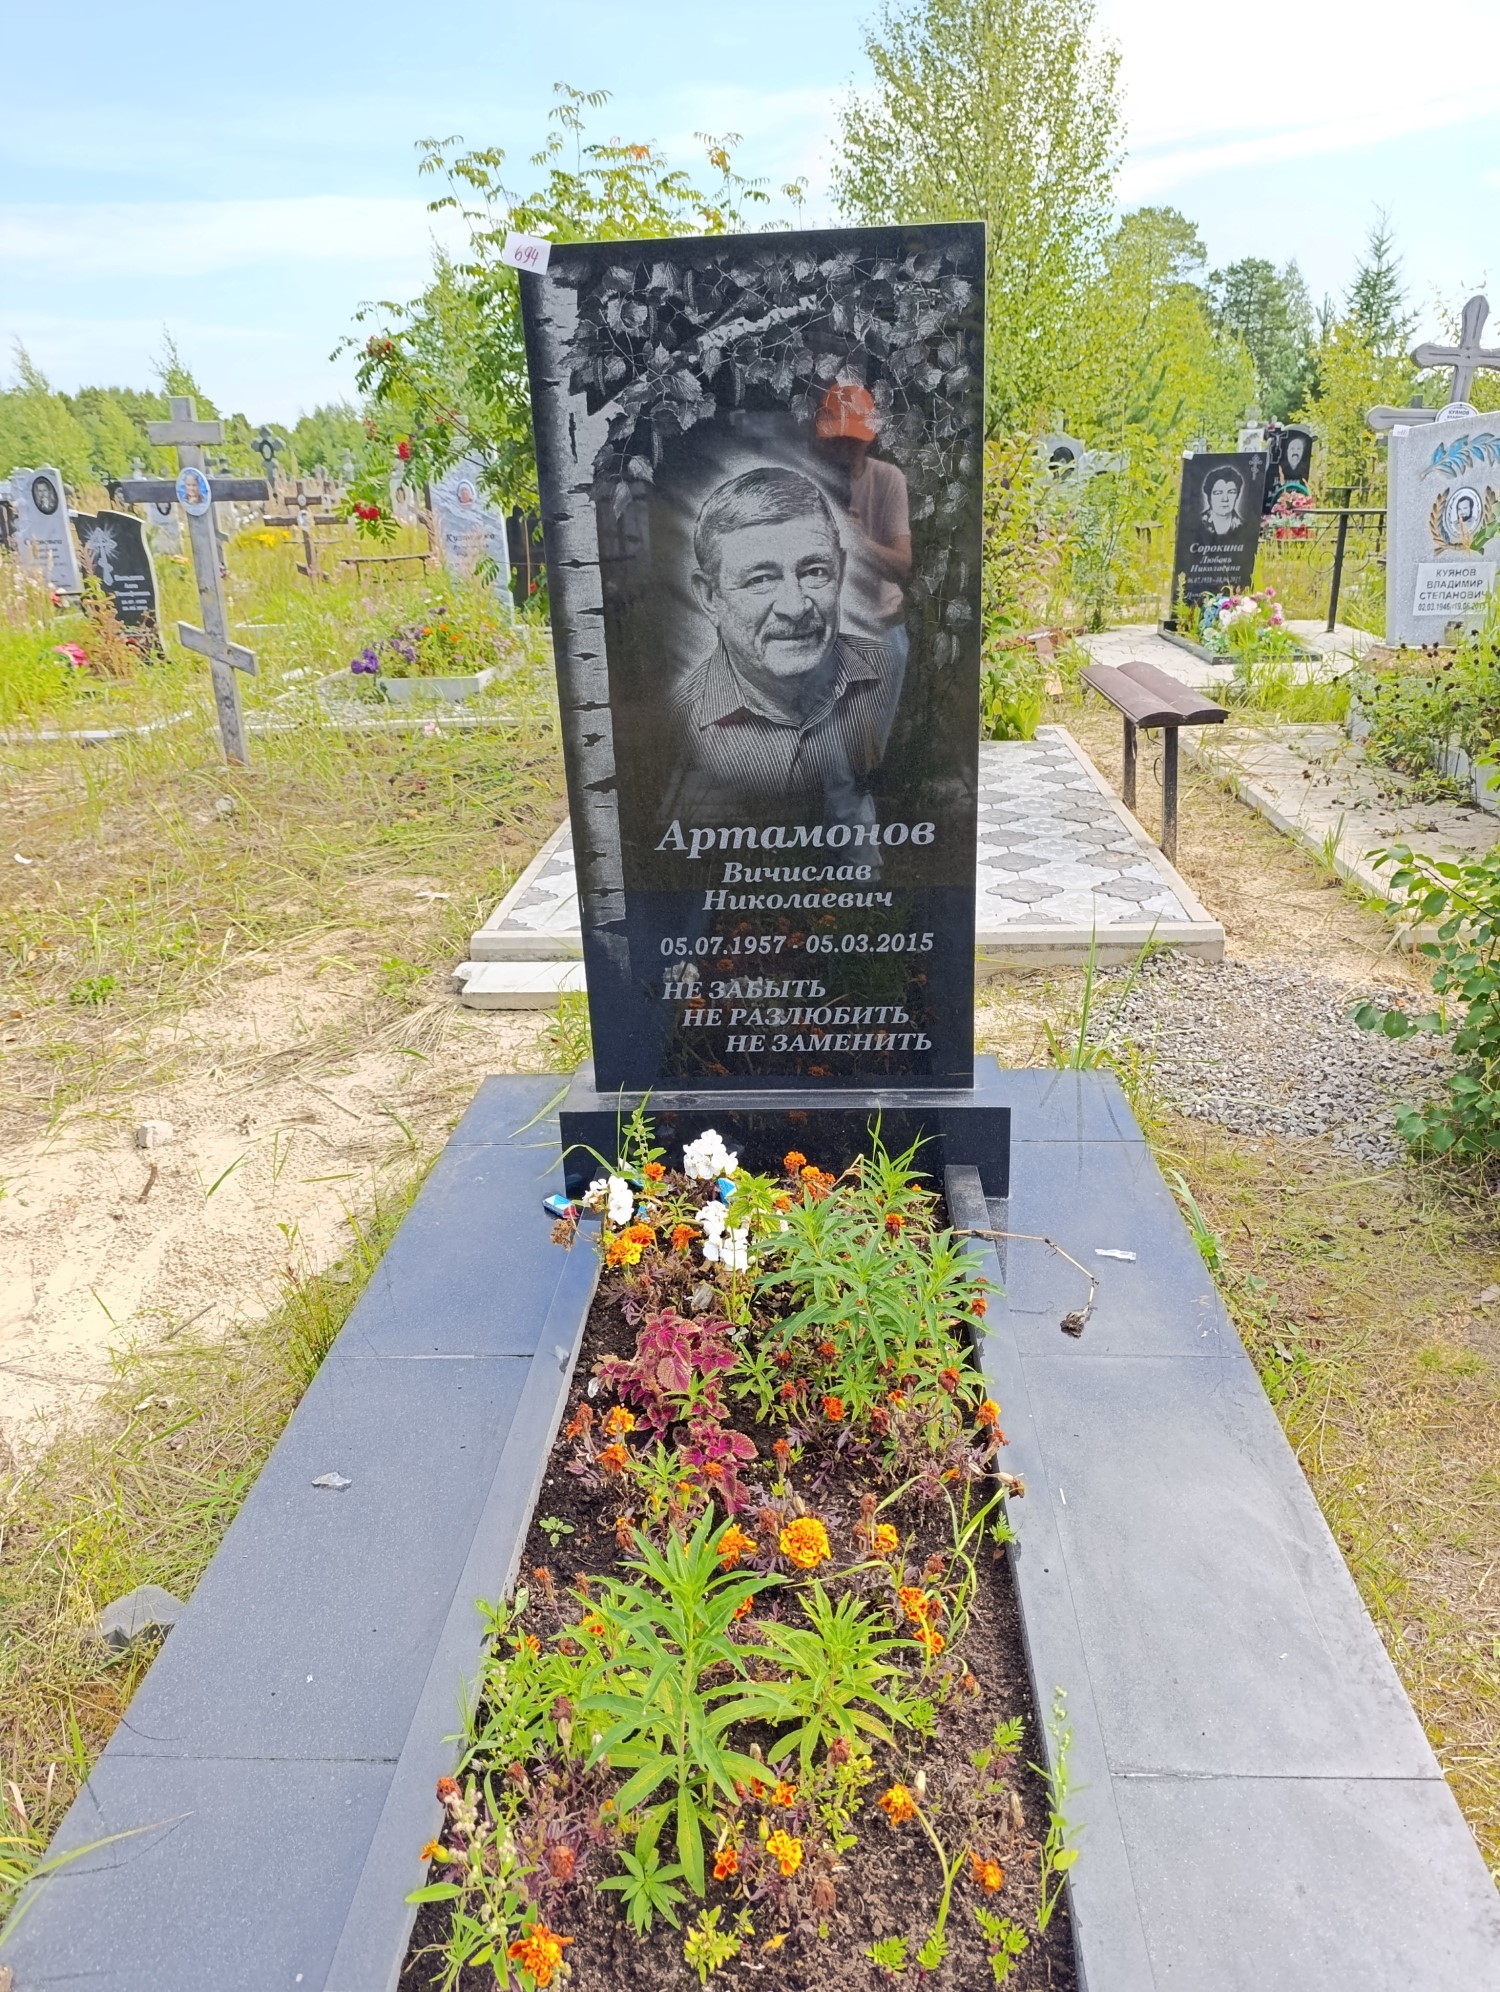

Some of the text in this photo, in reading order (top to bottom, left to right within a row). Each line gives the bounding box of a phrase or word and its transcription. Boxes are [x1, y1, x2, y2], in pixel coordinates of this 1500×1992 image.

[514, 244, 539, 267] 694
[1189, 543, 1244, 555] Сорокина
[1436, 568, 1477, 577] КУЯНОВ
[1426, 580, 1483, 589] ВЛАДИМИР
[1419, 591, 1487, 600] СТЕПАНОВИЧ
[654, 819, 936, 859] Артамонов
[721, 862, 872, 883] Вичислав
[702, 889, 893, 911] Николаевич
[660, 935, 787, 956] 05.07.1957
[805, 932, 934, 954] 05.03.2015
[662, 979, 826, 1000] НЕ ЗАБЫТЬ
[682, 1006, 910, 1027] НЕ РАЗЛЮБИТЬ
[725, 1032, 932, 1053] НЕ ЗАМЕНИТЬ
